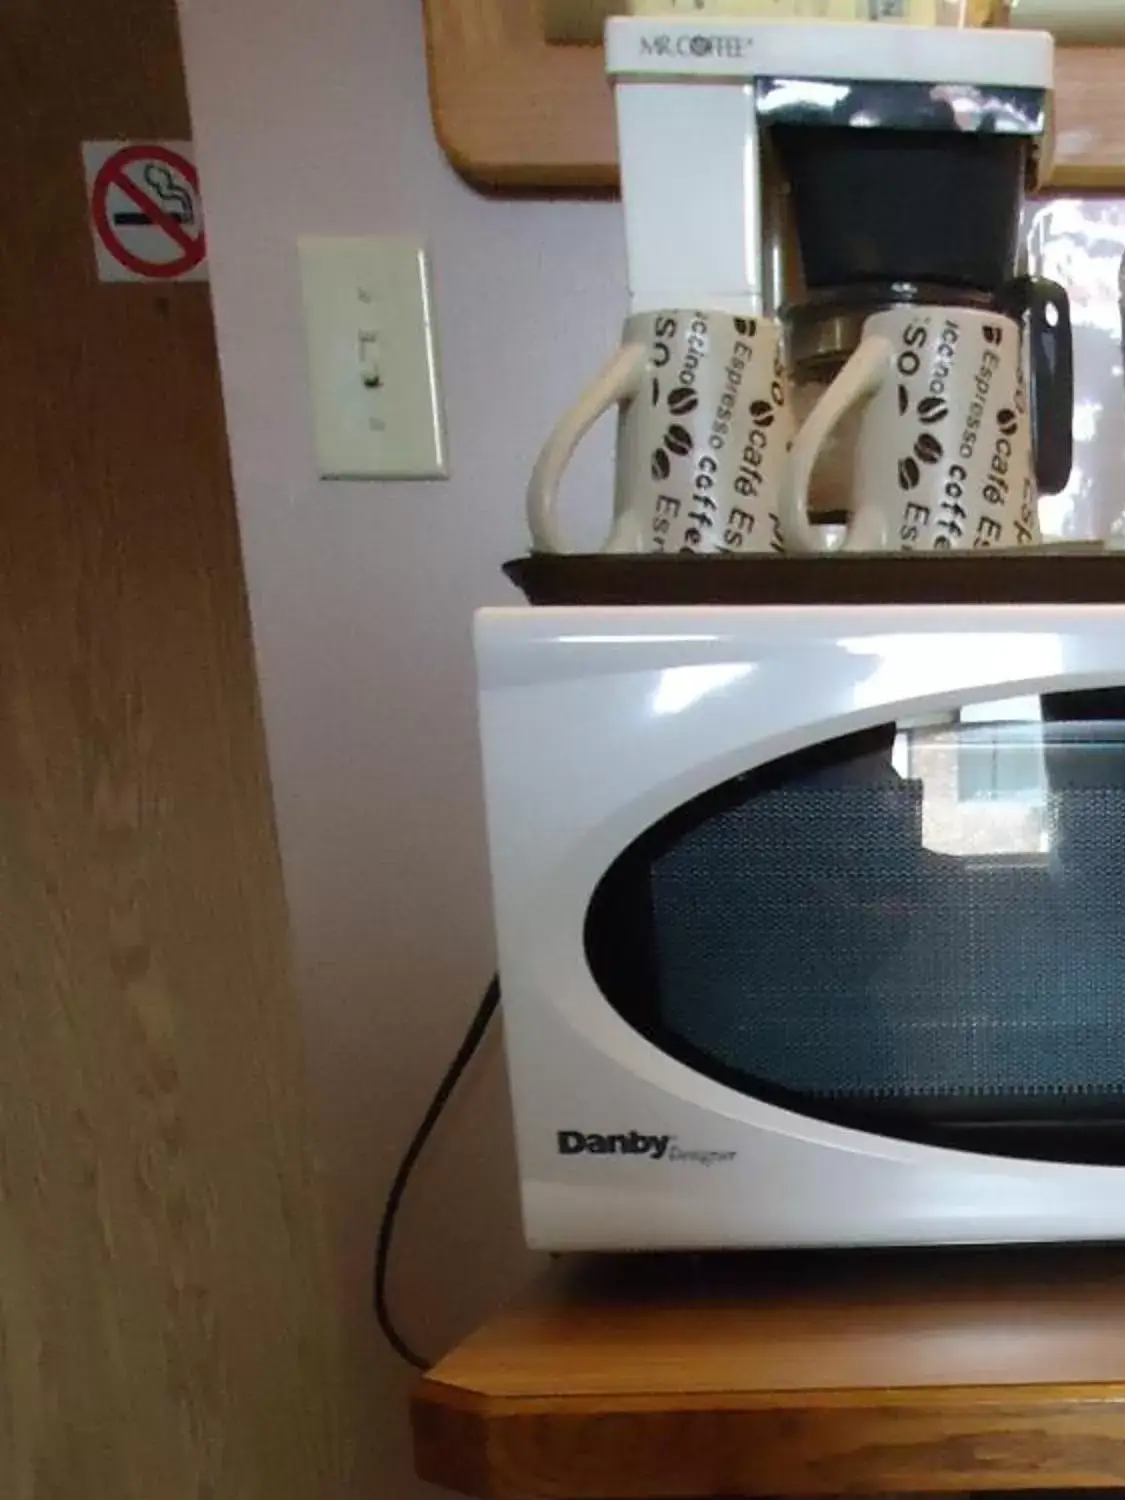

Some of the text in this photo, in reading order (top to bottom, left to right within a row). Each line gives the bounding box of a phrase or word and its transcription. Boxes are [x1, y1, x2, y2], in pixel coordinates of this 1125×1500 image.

[708, 341, 753, 450] Espresso
[959, 349, 1002, 460] Espresso
[733, 427, 768, 498] café
[982, 438, 1013, 508] café
[556, 1129, 670, 1160] Danby
